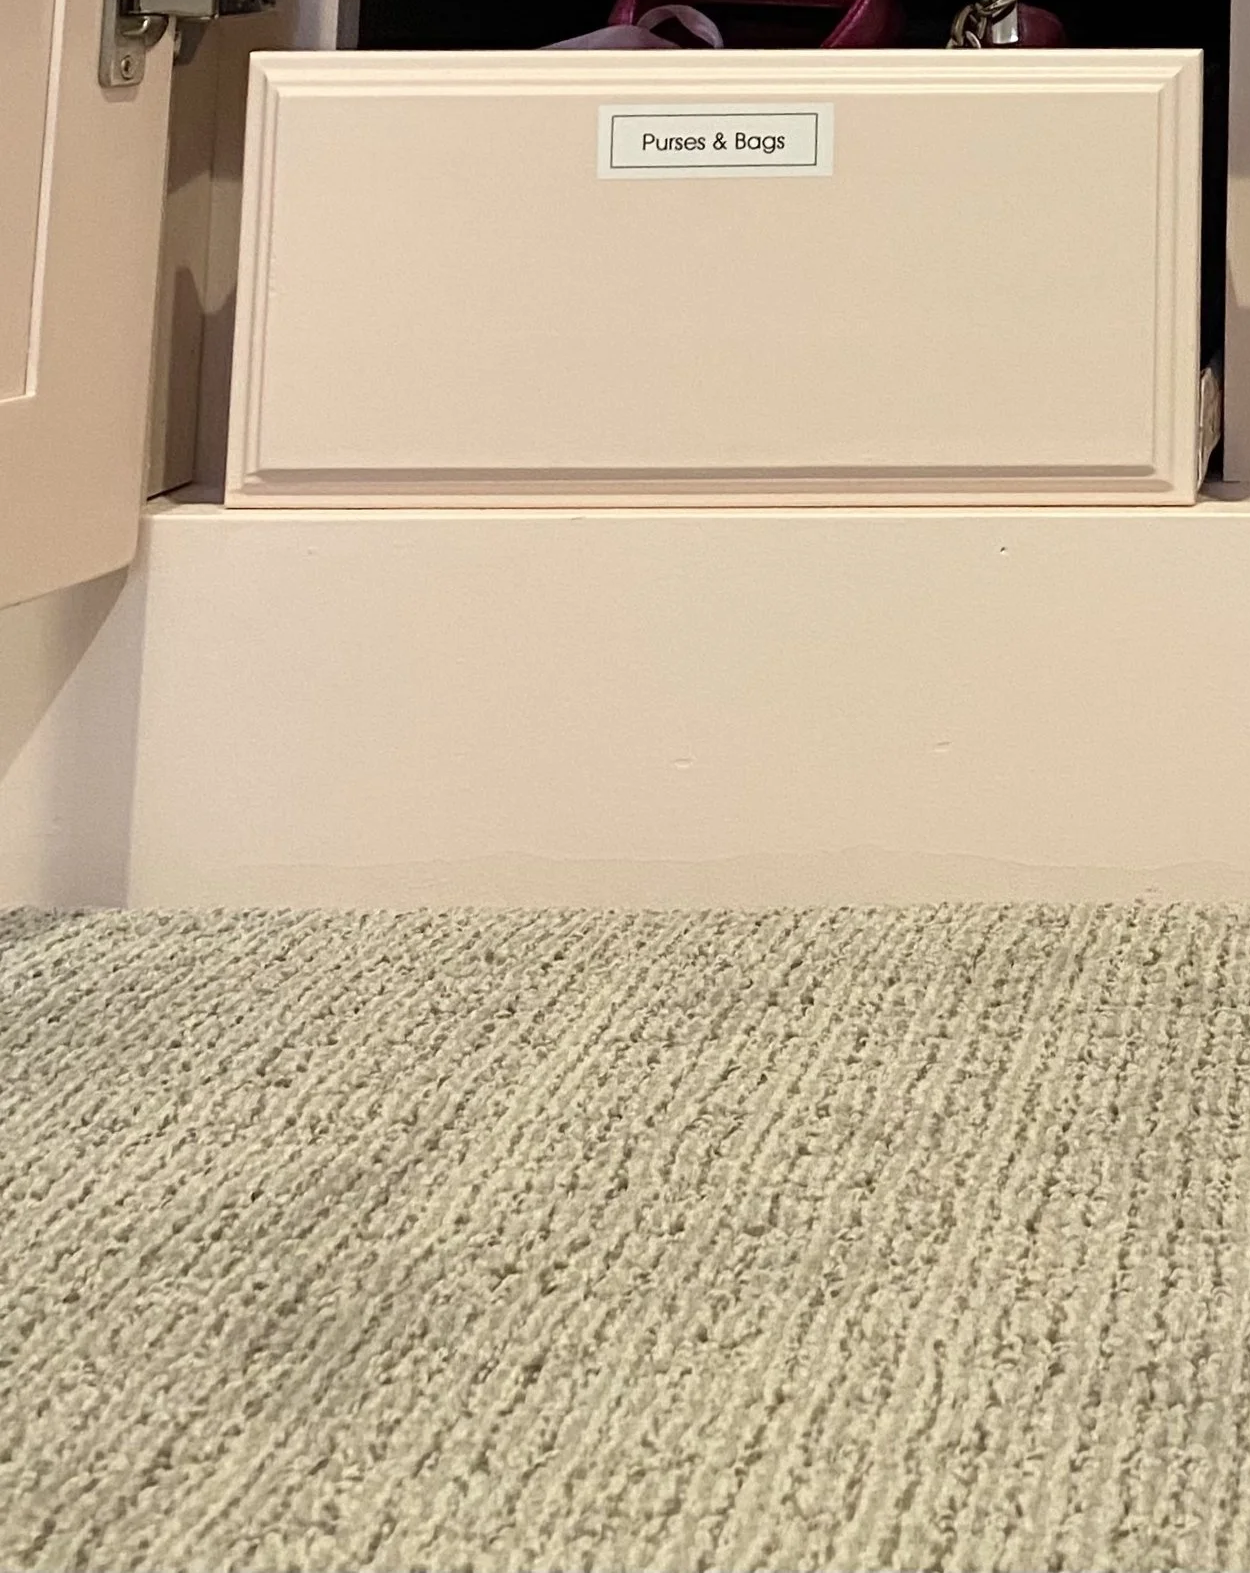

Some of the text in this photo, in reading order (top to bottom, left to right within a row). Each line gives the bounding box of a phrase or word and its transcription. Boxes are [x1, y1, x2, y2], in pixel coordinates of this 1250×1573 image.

[642, 132, 785, 154] Purses & Bags
